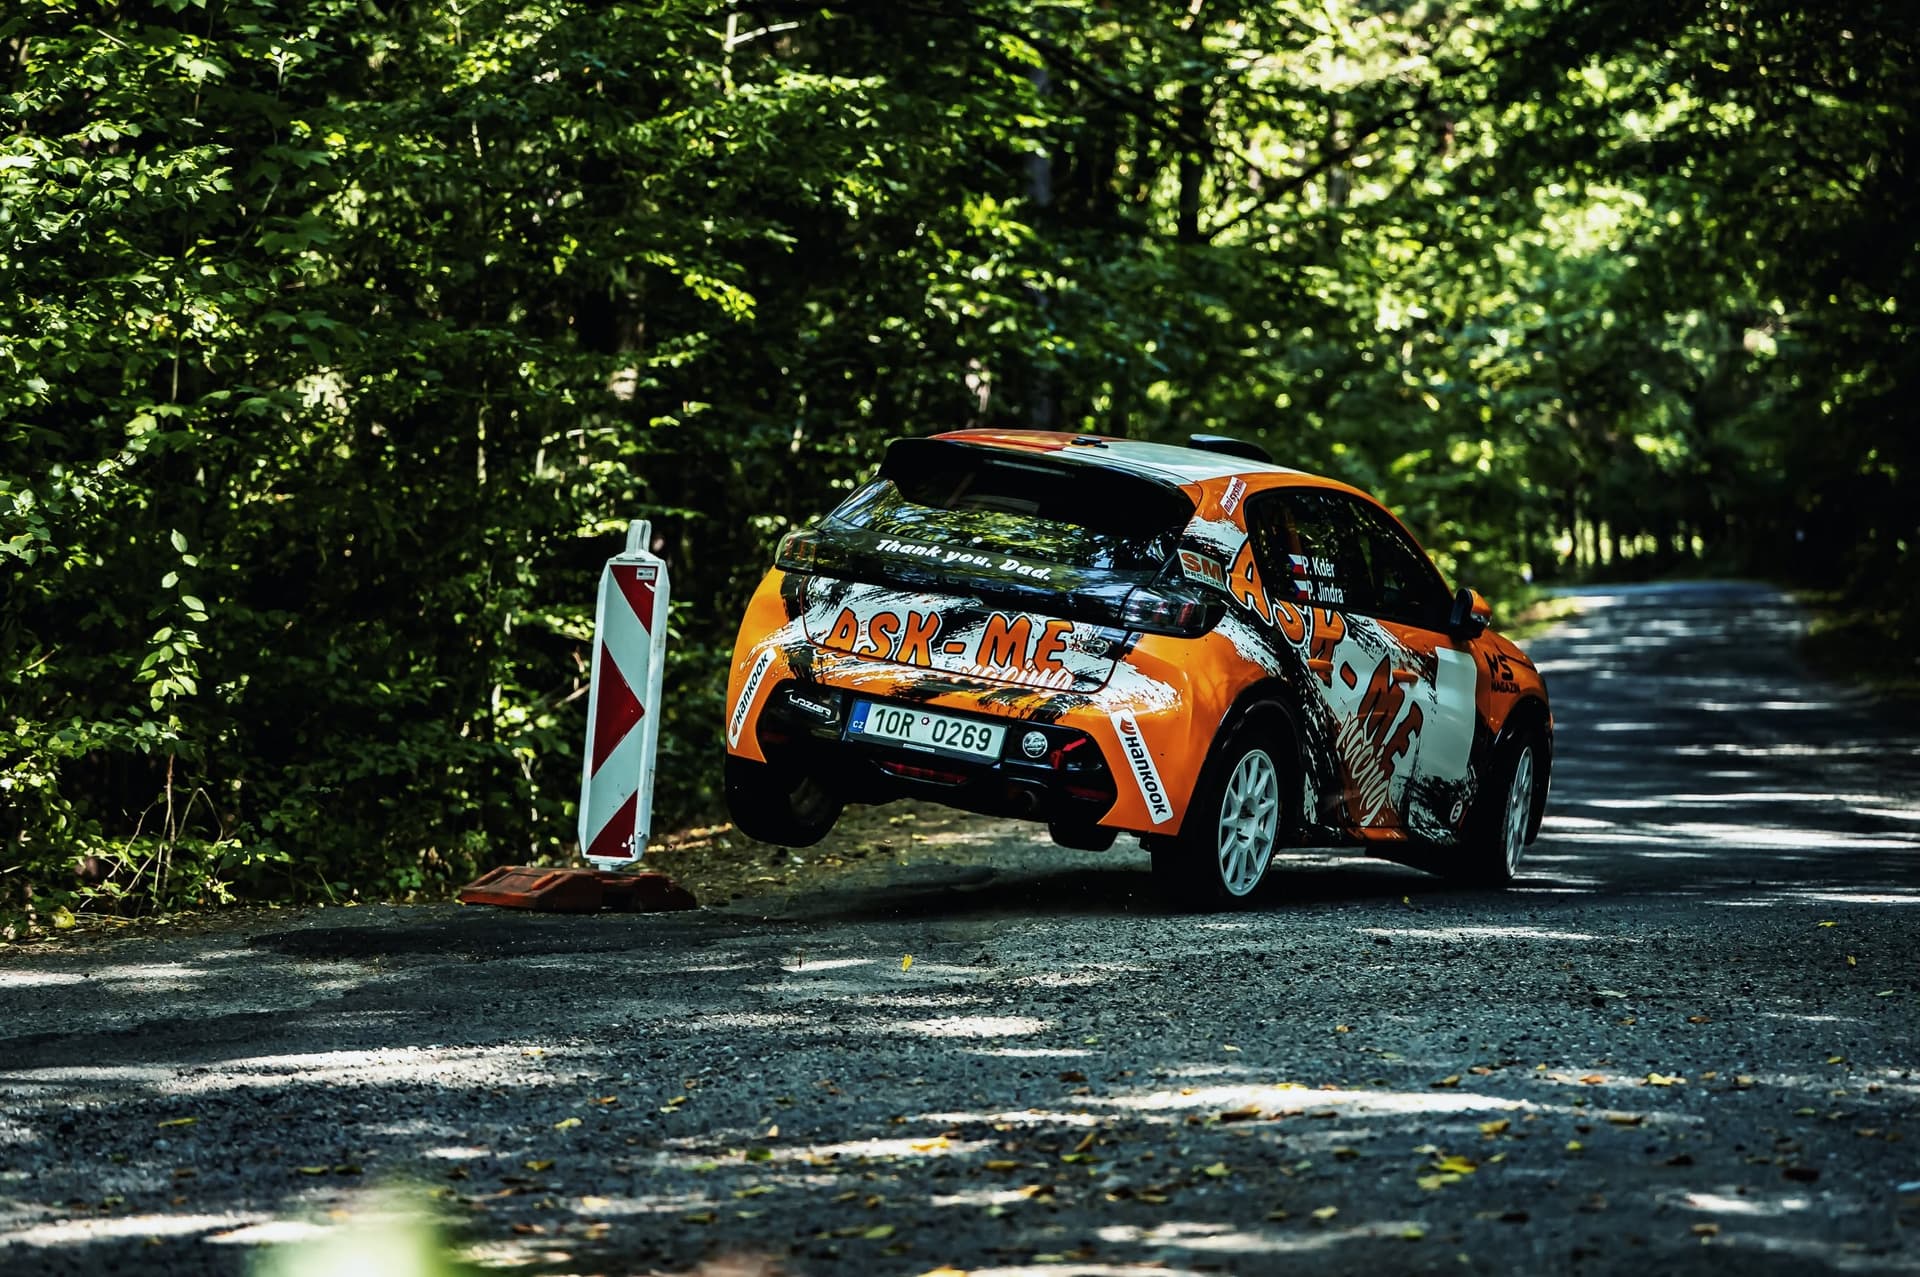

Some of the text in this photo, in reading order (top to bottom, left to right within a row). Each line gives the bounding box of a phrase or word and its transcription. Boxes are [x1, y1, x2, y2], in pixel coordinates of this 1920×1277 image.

[875, 539, 942, 558] Thank
[998, 558, 1053, 581] Dad.
[1180, 552, 1223, 583] SM
[1302, 555, 1312, 575] P.
[1306, 580, 1344, 604] P. Jindra
[823, 608, 1075, 671] ASK-ME
[853, 720, 864, 729] CZ
[875, 708, 916, 738] 10R
[932, 719, 993, 752] 0269
